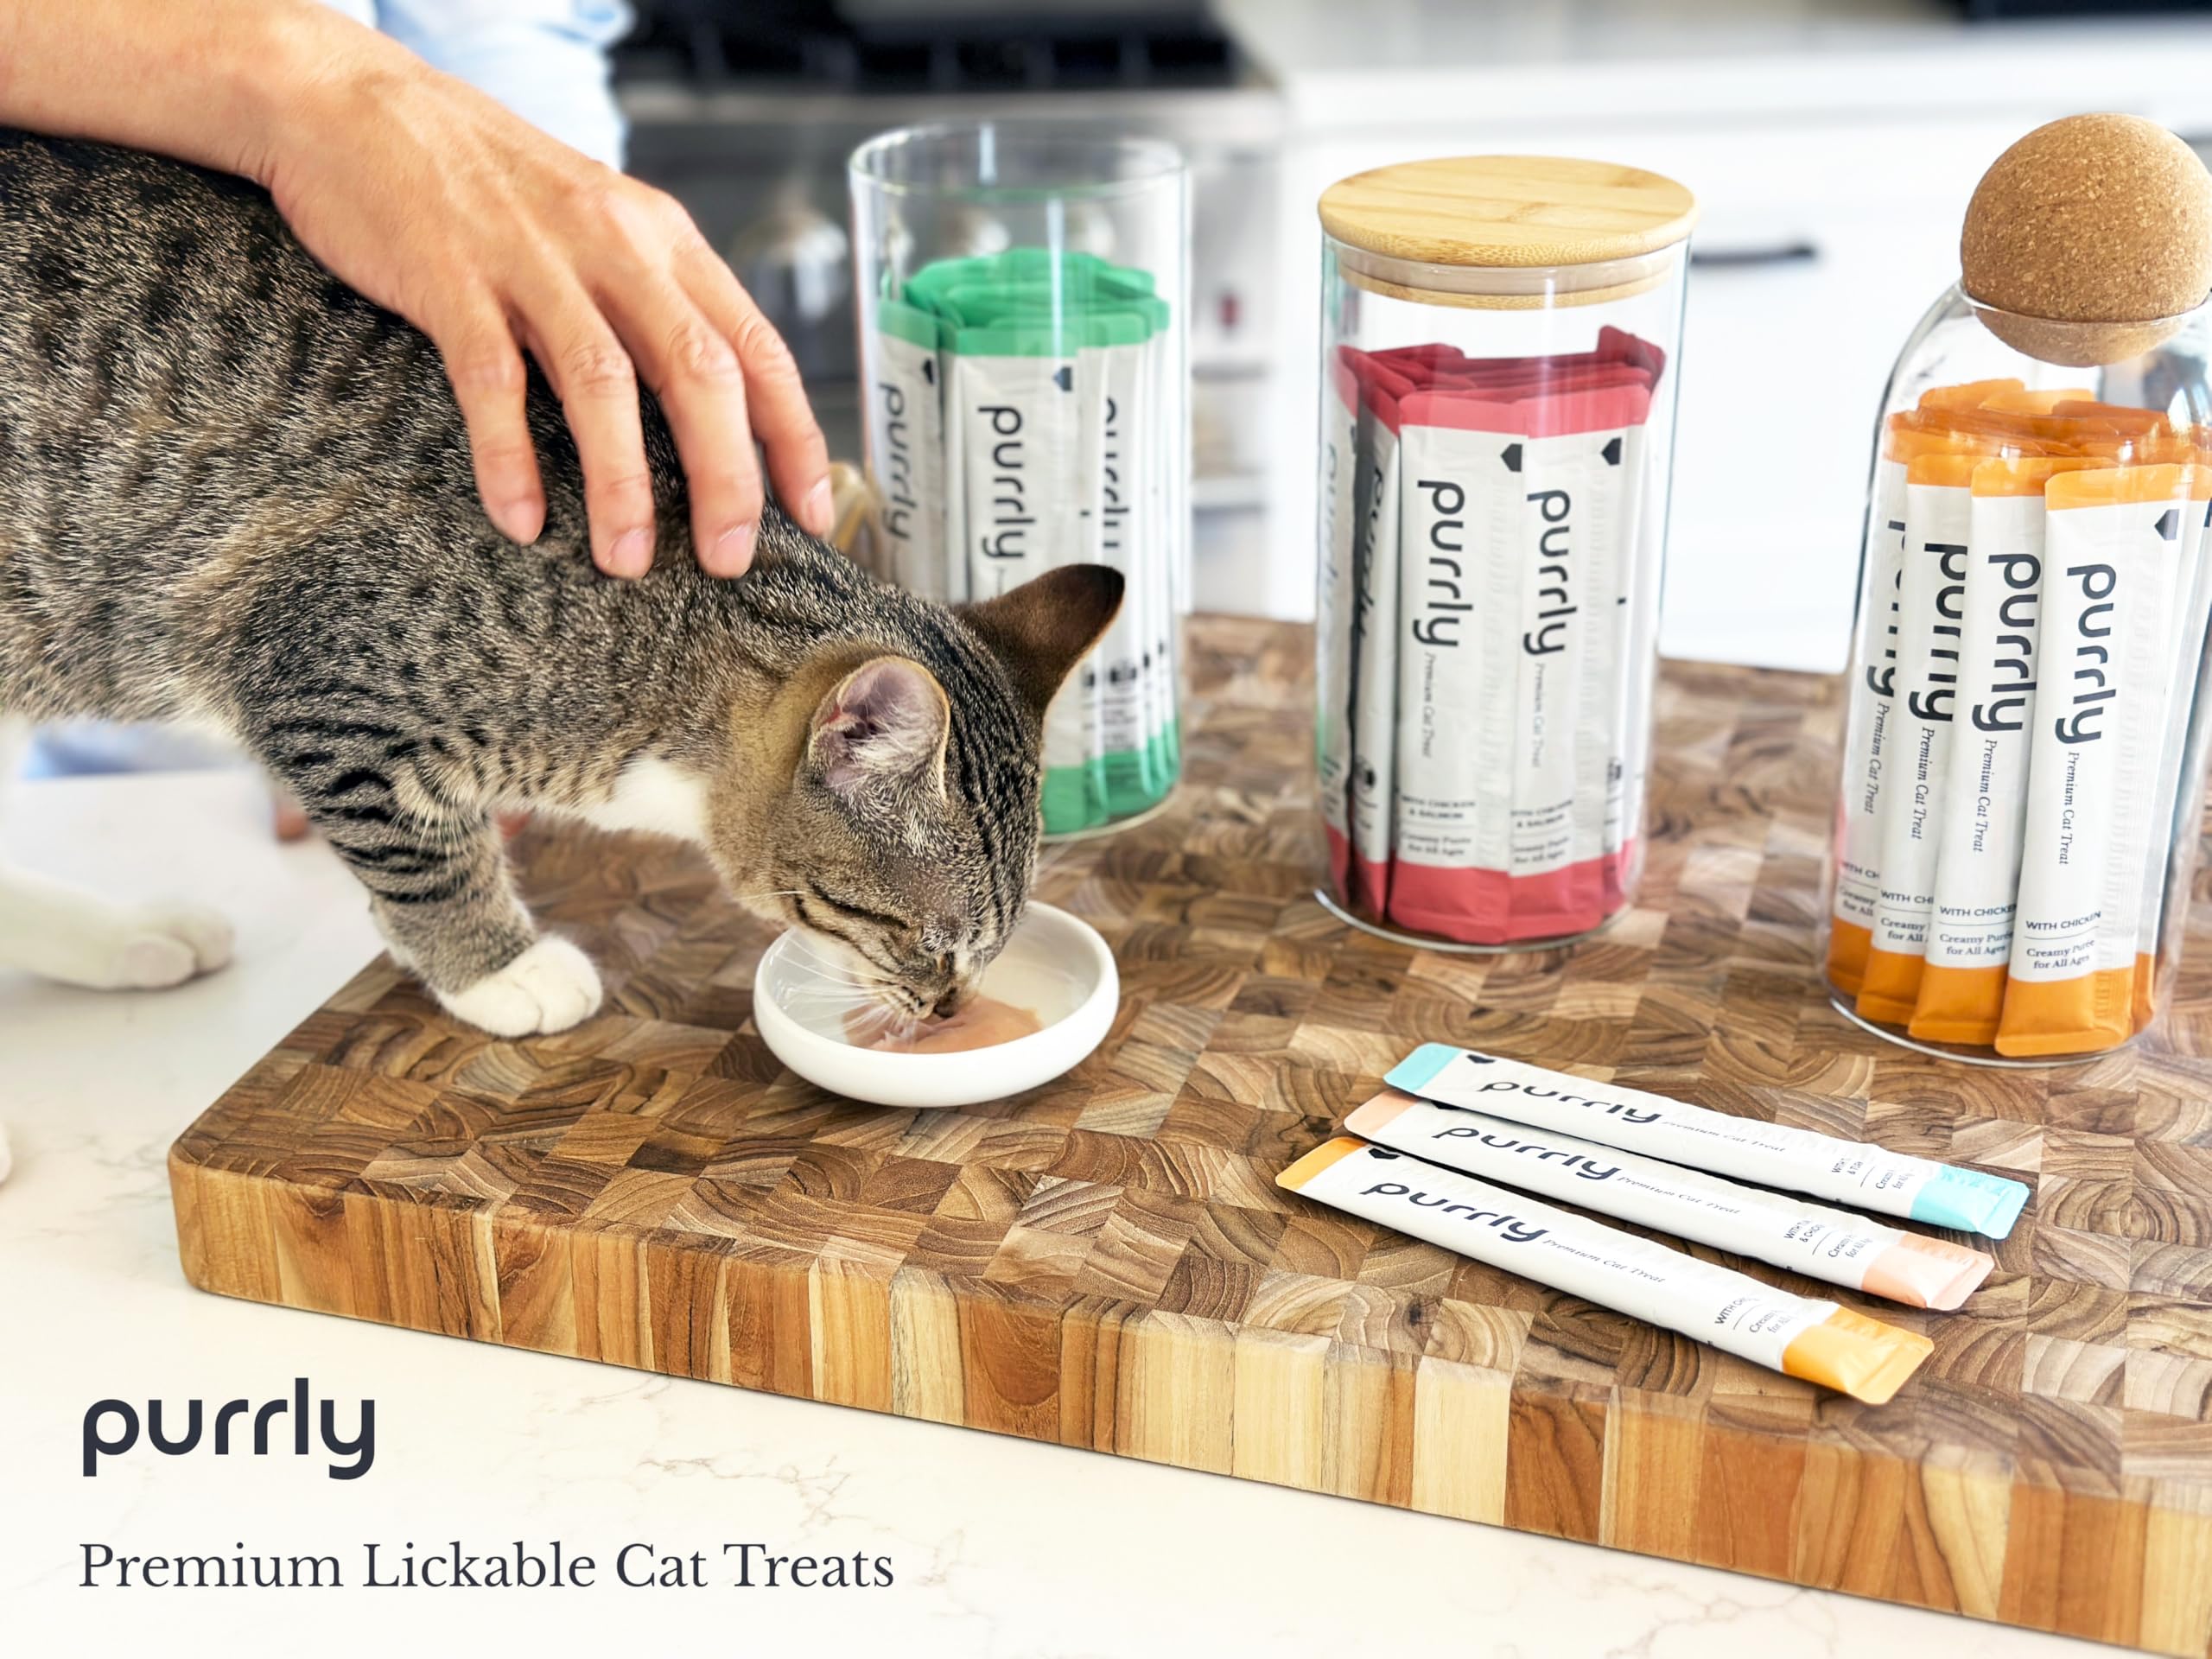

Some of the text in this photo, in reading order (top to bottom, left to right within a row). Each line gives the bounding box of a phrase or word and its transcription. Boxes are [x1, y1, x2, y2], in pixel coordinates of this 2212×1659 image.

[877, 382, 918, 540] purrly
[978, 404, 1036, 560] purrly
[1413, 479, 1473, 648] purrly
[1523, 489, 1577, 656] purrly
[1972, 553, 2041, 732] purrly
[2055, 563, 2117, 745] purrly
[1864, 702, 1891, 814] Premium Cat Treat
[1910, 726, 1936, 841] Premium Cat Treat
[1973, 738, 1998, 853] Premium Cat Treat
[2058, 750, 2080, 866] Premium Cat Treat
[1880, 889, 1910, 902] WITH
[1880, 917, 1927, 932] Creamy
[1887, 930, 1924, 943] for All
[1939, 906, 1971, 918] WITH
[1939, 931, 1985, 945] Creamy
[2025, 910, 2102, 931] WITH CHICKEN
[1946, 946, 1964, 956] for
[1965, 945, 1981, 956] All
[2025, 946, 2071, 958] Creamy
[2032, 960, 2051, 970] for
[2052, 958, 2069, 969] All
[1476, 1081, 1665, 1124] purrly
[1430, 1127, 1742, 1215] purrly Premium Cat Treat
[1357, 1182, 1667, 1283] purrly Premium Cat Treat
[1714, 1304, 1737, 1325] WITH
